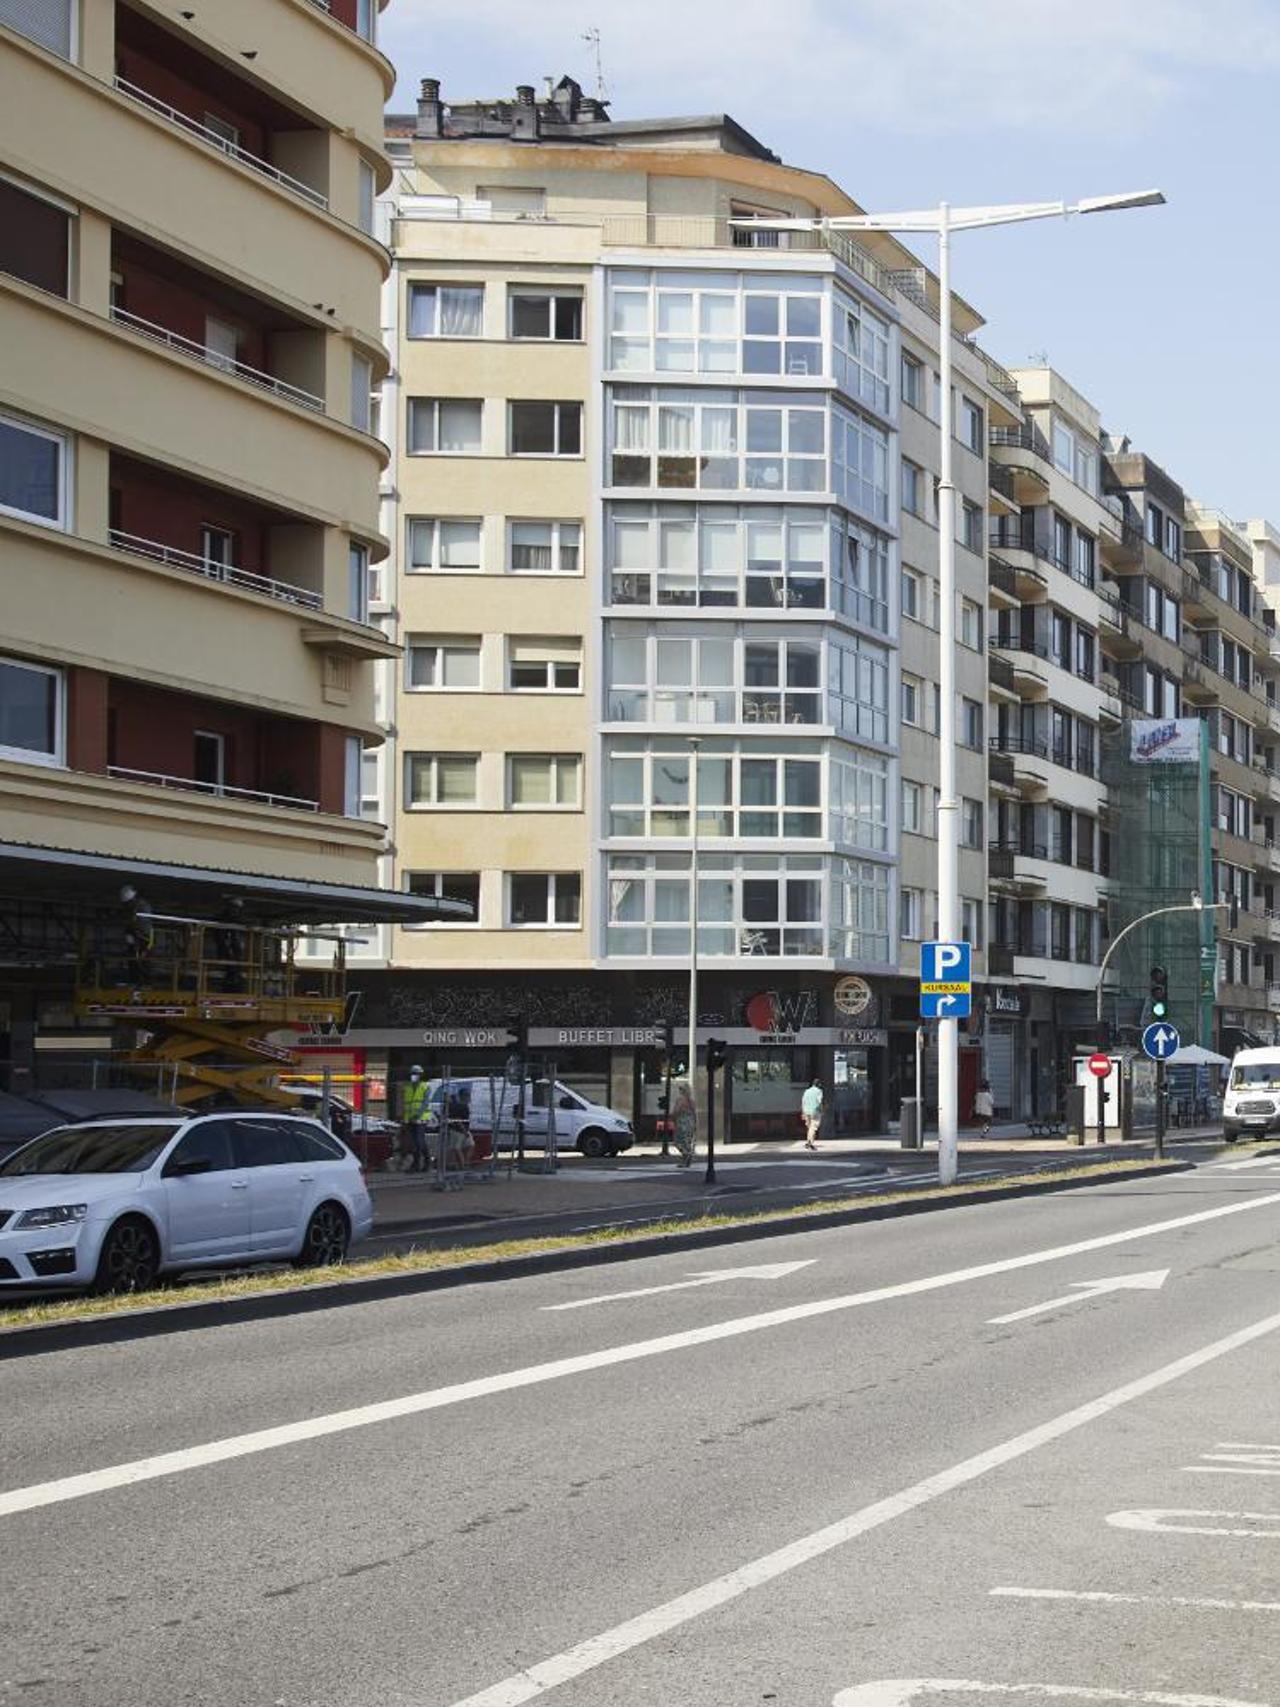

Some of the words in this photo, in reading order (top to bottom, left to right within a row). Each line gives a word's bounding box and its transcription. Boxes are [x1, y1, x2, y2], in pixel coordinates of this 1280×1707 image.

[935, 945, 961, 980] P
[423, 1030, 457, 1044] QING
[464, 1029, 497, 1047] WOK
[558, 1030, 614, 1043] BUFFET
